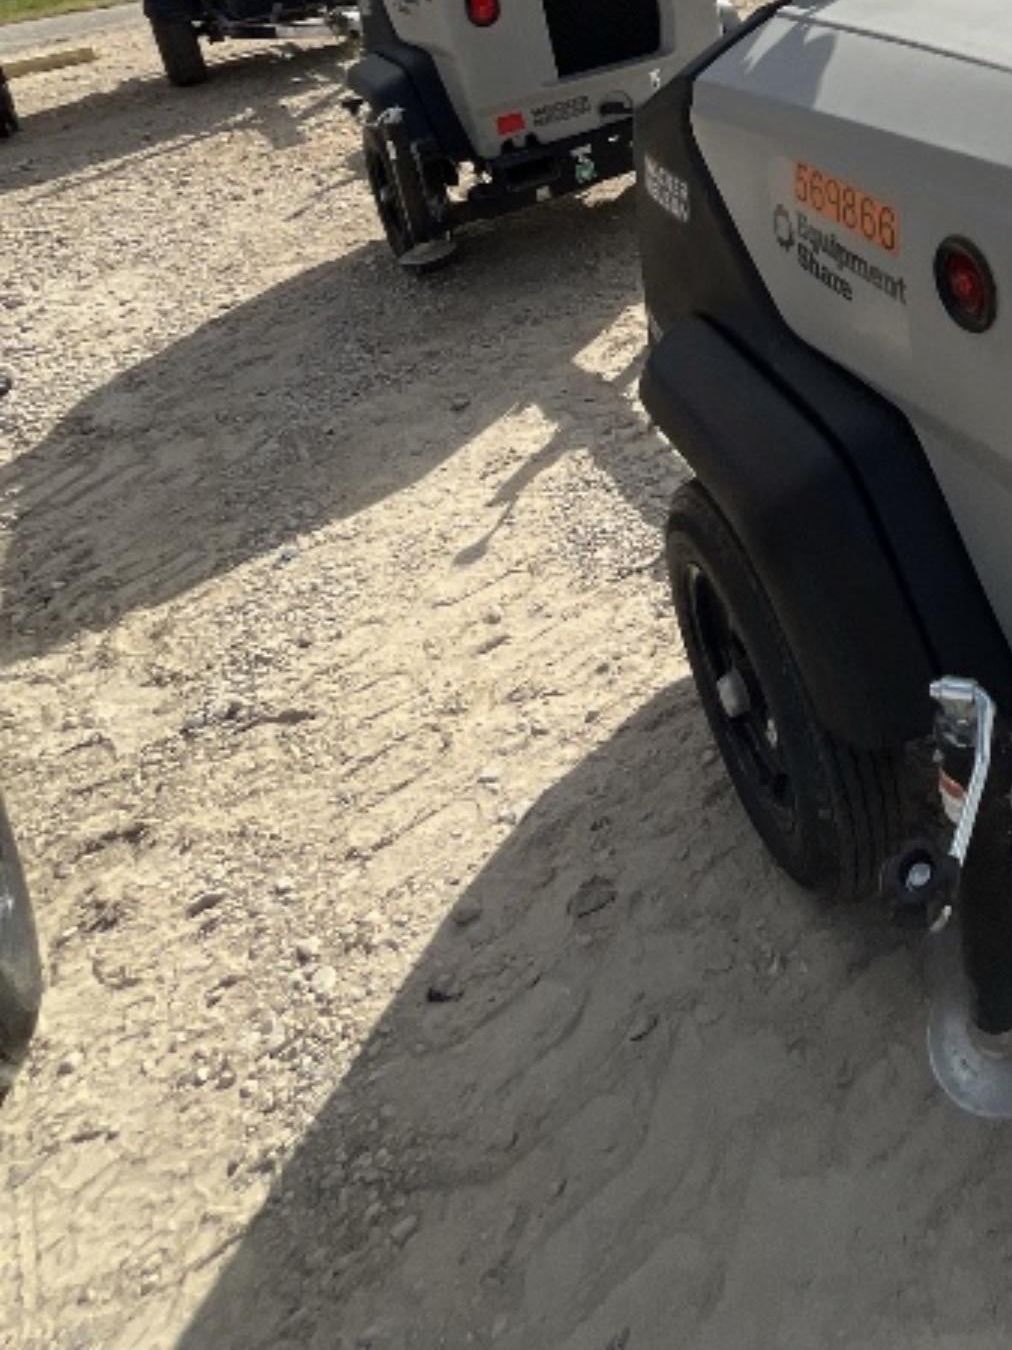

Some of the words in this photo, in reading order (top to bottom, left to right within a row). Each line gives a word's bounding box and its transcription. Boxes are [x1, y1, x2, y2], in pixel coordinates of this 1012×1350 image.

[795, 163, 896, 251] 569866
[796, 210, 907, 305] Equipment
[797, 242, 853, 301] Share
